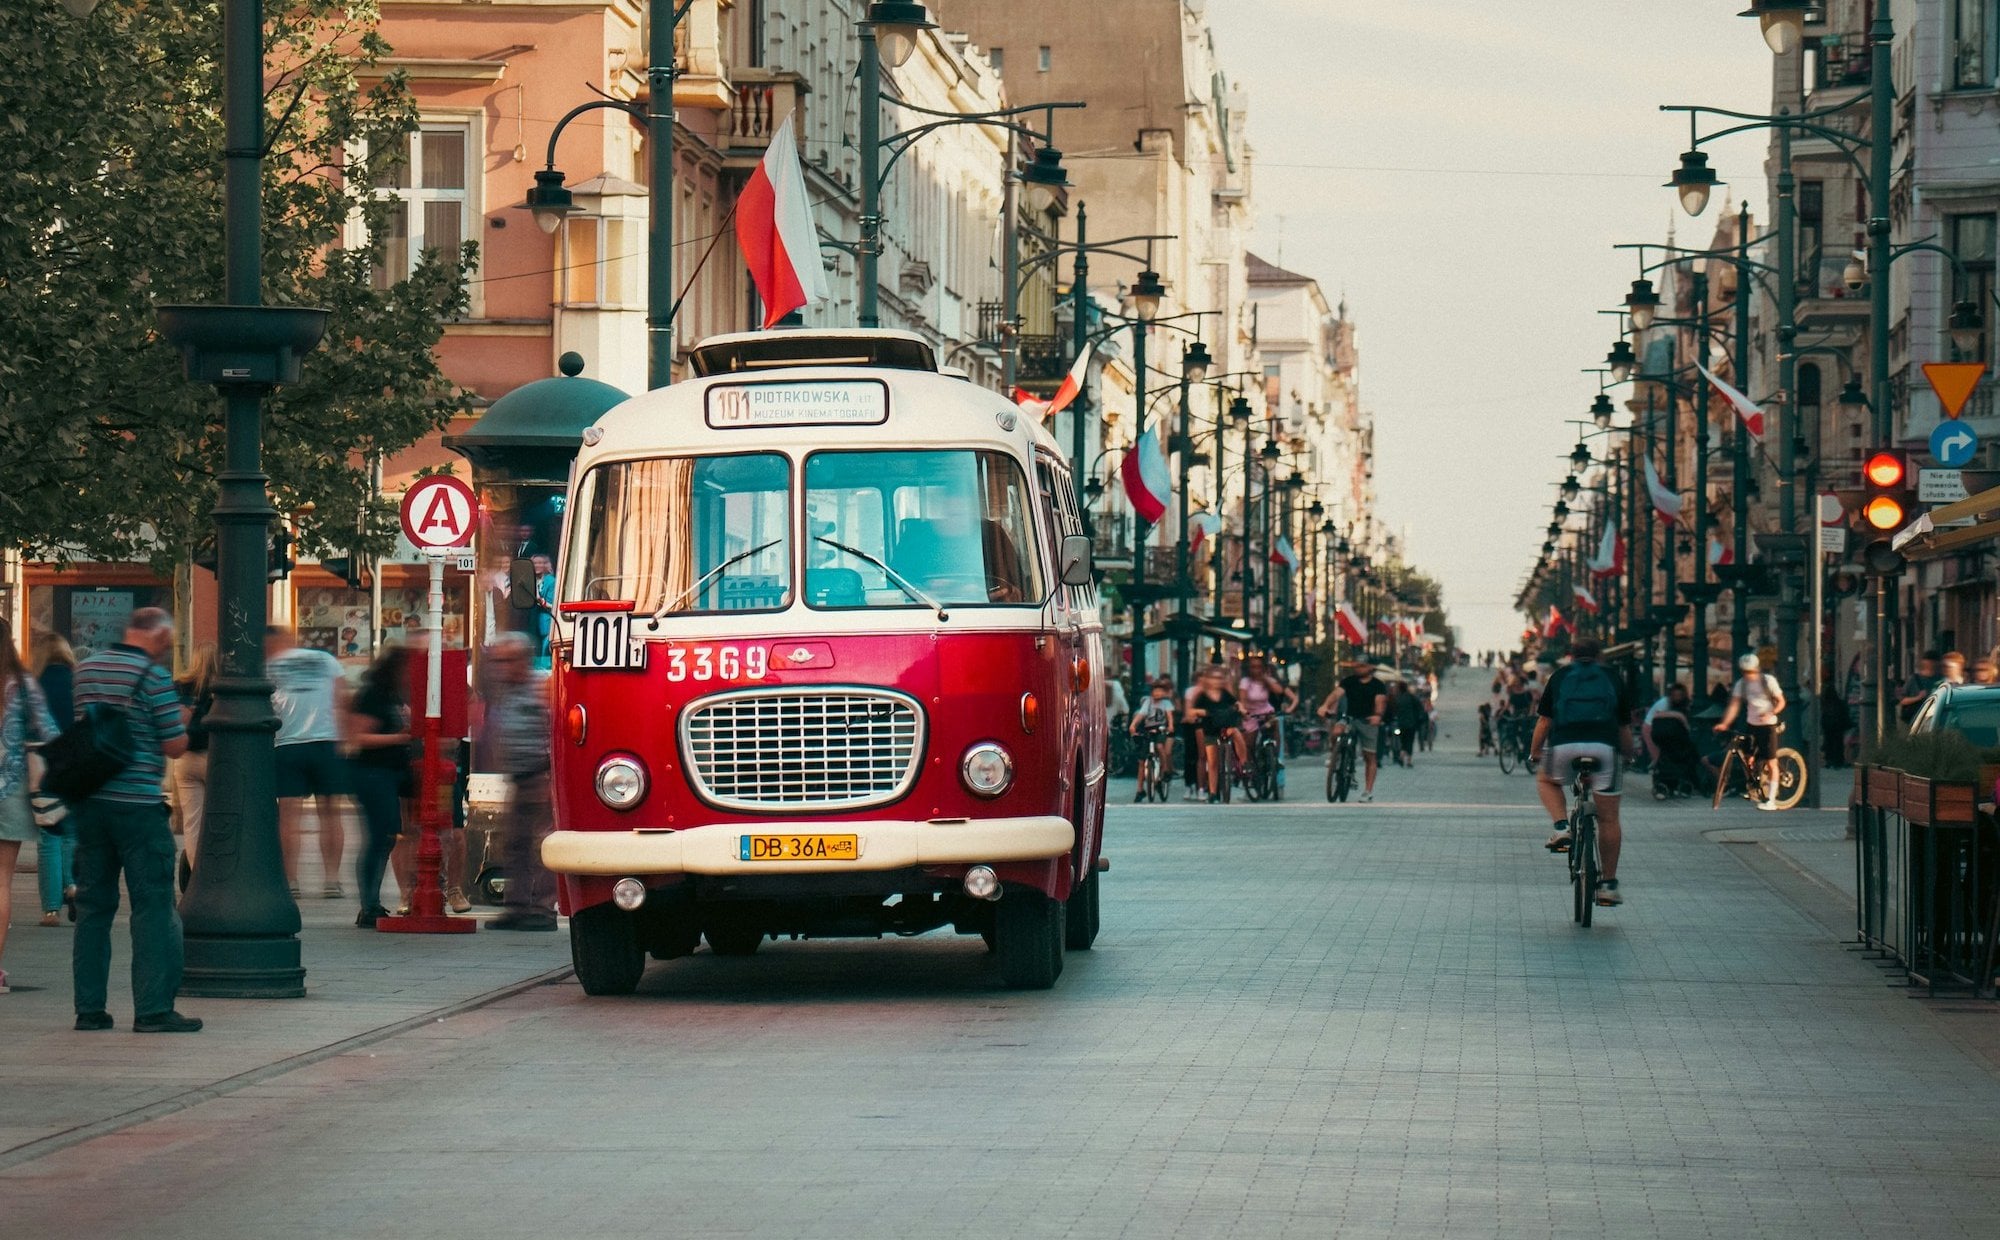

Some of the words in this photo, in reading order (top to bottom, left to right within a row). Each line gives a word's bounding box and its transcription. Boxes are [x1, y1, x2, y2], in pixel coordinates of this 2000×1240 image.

[718, 391, 750, 420] 101
[754, 391, 850, 404] PIOTRKOWSKA
[754, 408, 795, 419] MUZEUM
[799, 408, 875, 418] KINEMATOGRAFII
[418, 487, 460, 535] A
[458, 559, 474, 568] 101
[579, 616, 622, 666] 101
[667, 646, 766, 682] 3369
[754, 838, 782, 857] DB
[790, 837, 827, 857] 36A
